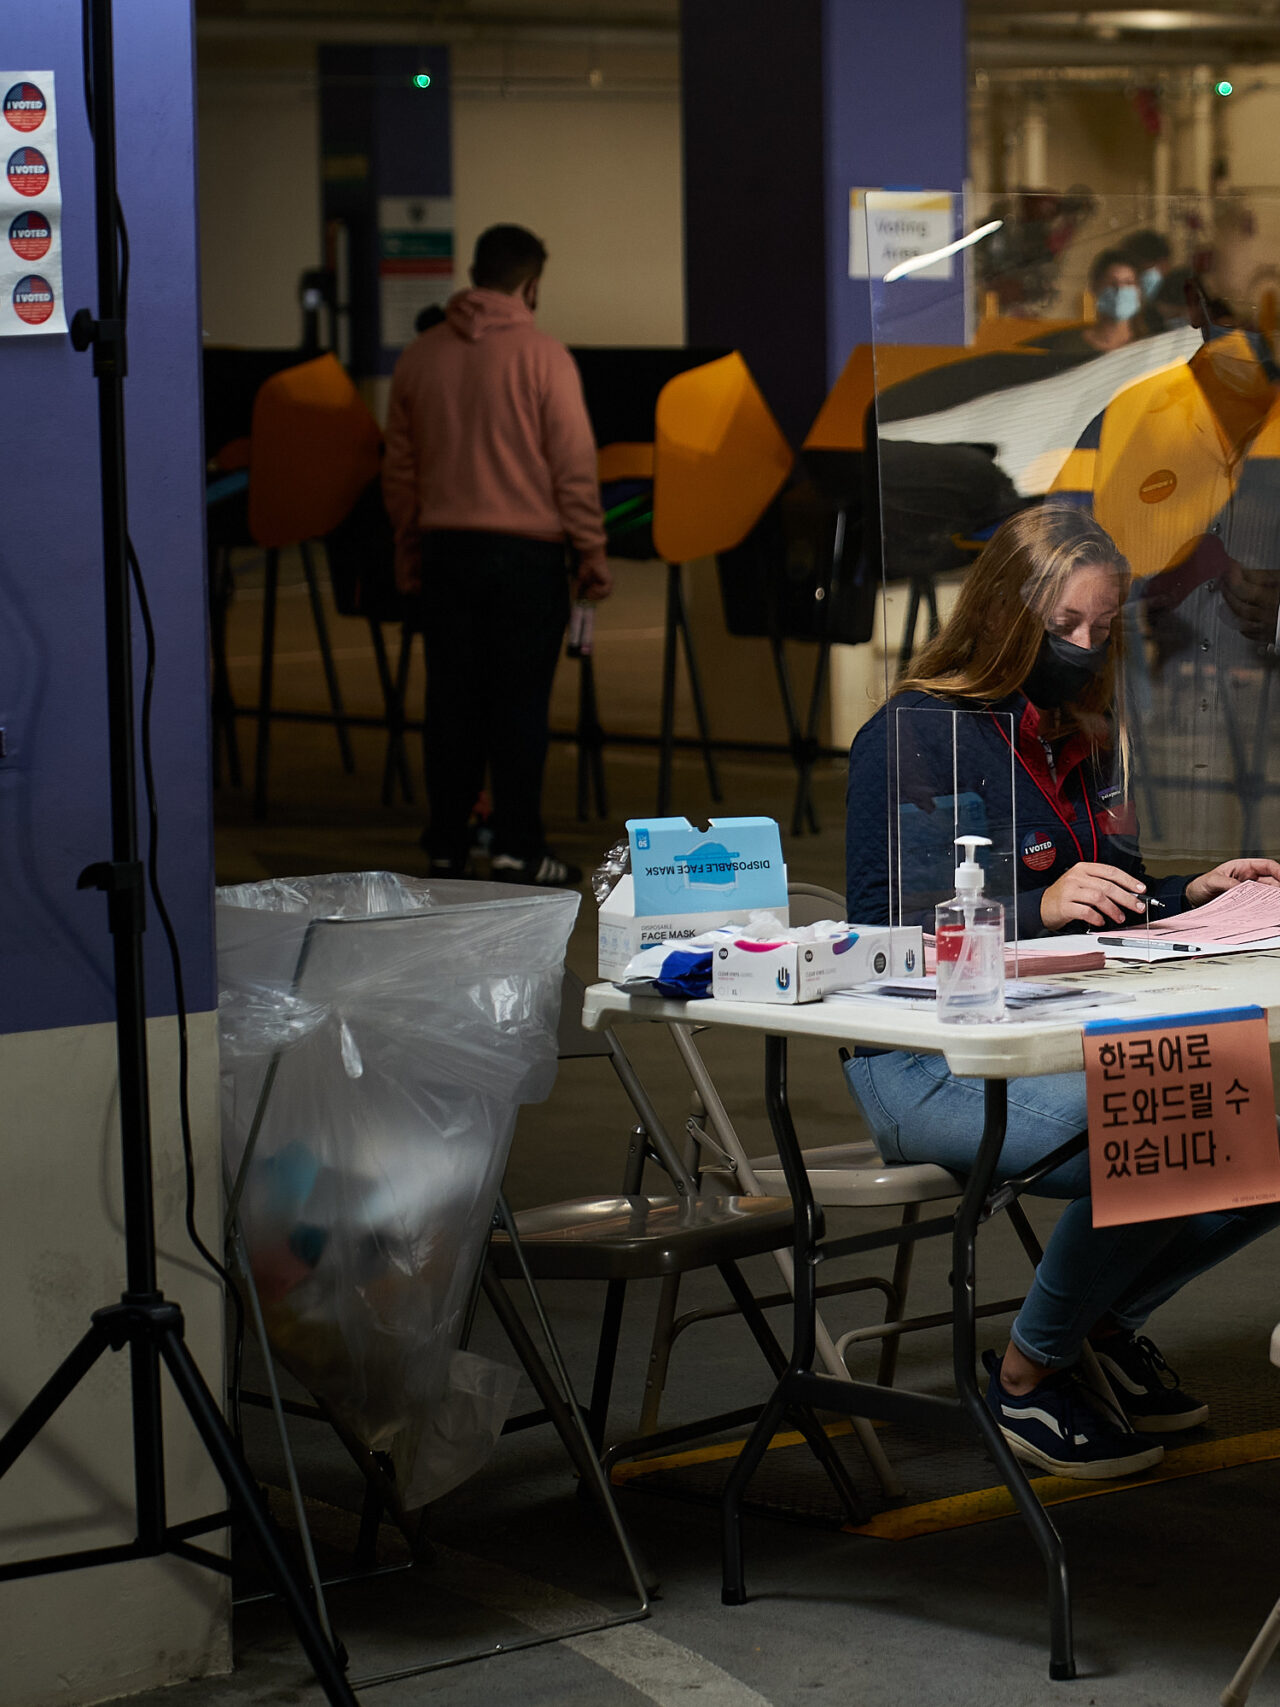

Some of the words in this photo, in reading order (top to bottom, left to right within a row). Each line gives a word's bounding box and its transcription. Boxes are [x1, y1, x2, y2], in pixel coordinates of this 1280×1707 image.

[12, 101, 43, 109] VOTED
[15, 165, 46, 174] VOTED
[17, 229, 48, 238] VOTED
[20, 293, 51, 302] VOTED
[1029, 841, 1052, 853] VOTED
[645, 866, 675, 876] MASK
[678, 865, 704, 874] FACE
[706, 860, 770, 873] DISPOSABLE
[641, 931, 667, 941] FACE
[668, 930, 696, 940] MASK
[1098, 1033, 1212, 1081] 한국어로
[1102, 1081, 1213, 1128] 도와드릴
[1225, 1078, 1250, 1115] 수
